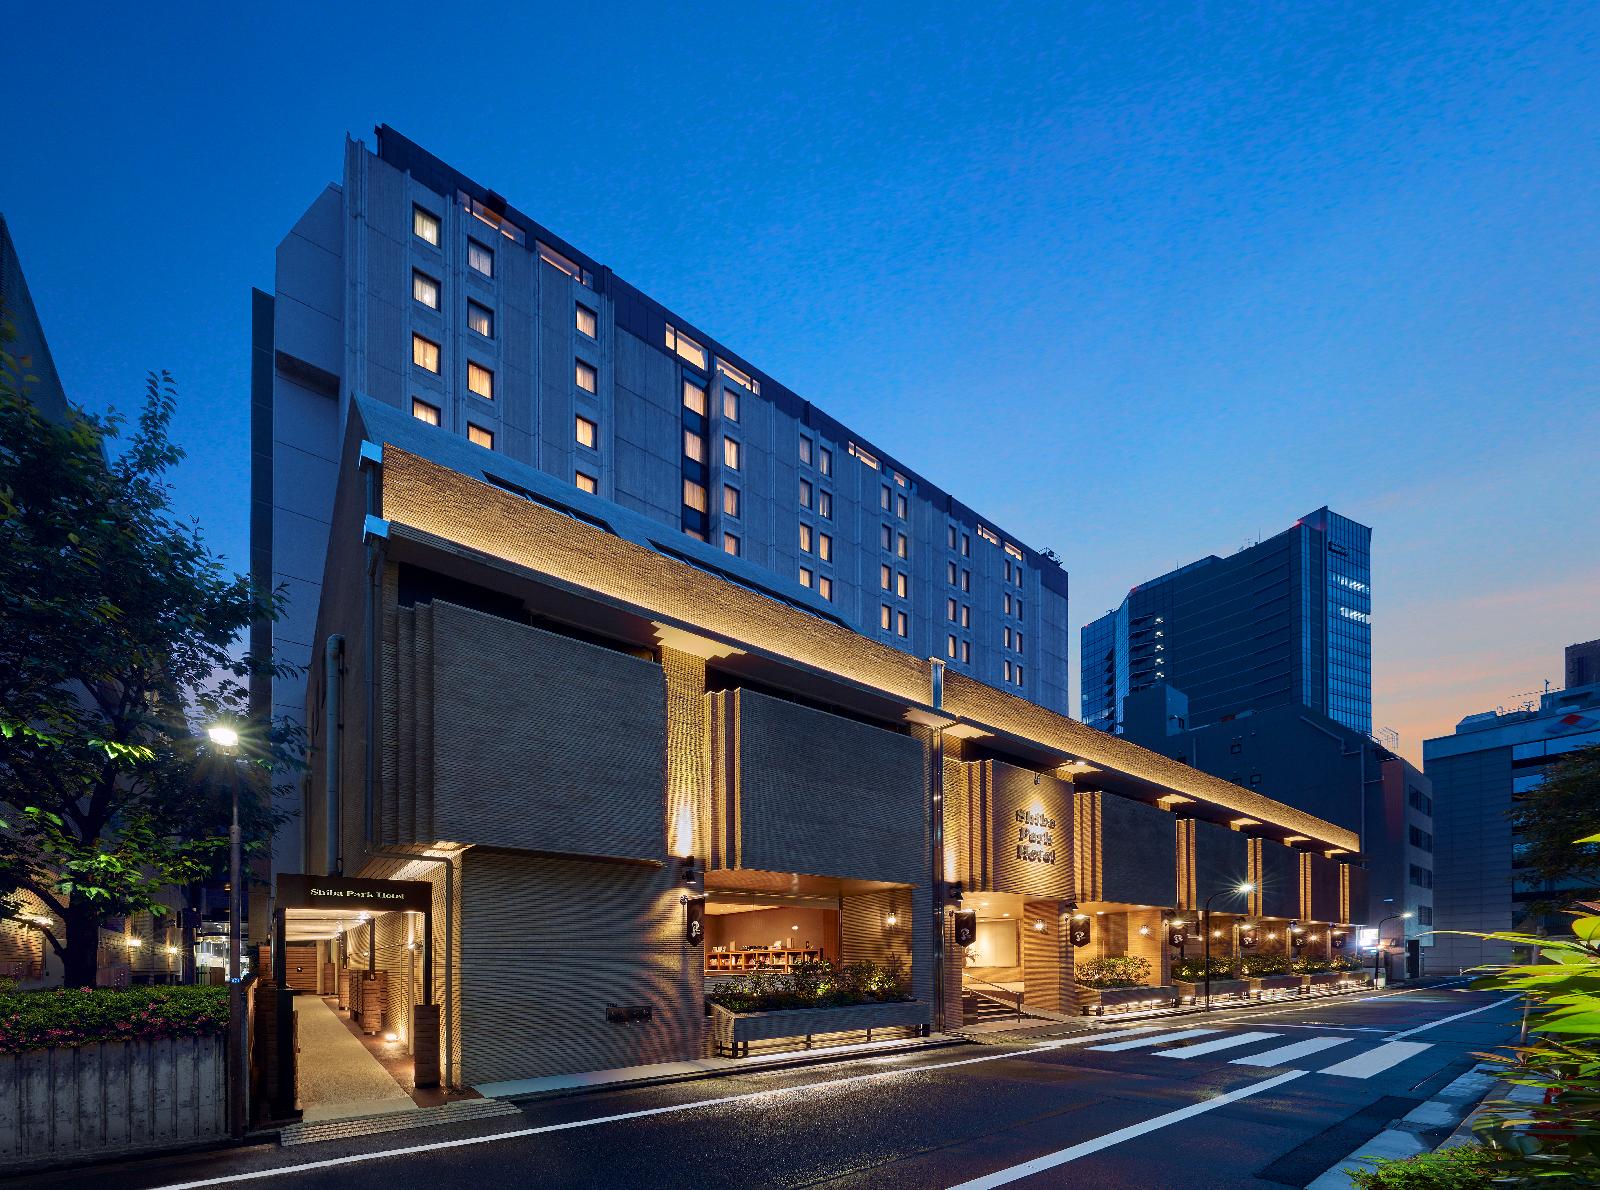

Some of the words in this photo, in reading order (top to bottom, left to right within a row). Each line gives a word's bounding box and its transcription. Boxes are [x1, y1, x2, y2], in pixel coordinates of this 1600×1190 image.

[1015, 808, 1056, 830] Shiba
[1018, 826, 1053, 847] Park
[1016, 844, 1056, 866] Hotel
[310, 888, 344, 897] Shiba
[346, 890, 374, 898] Park
[376, 891, 405, 900] Hotel
